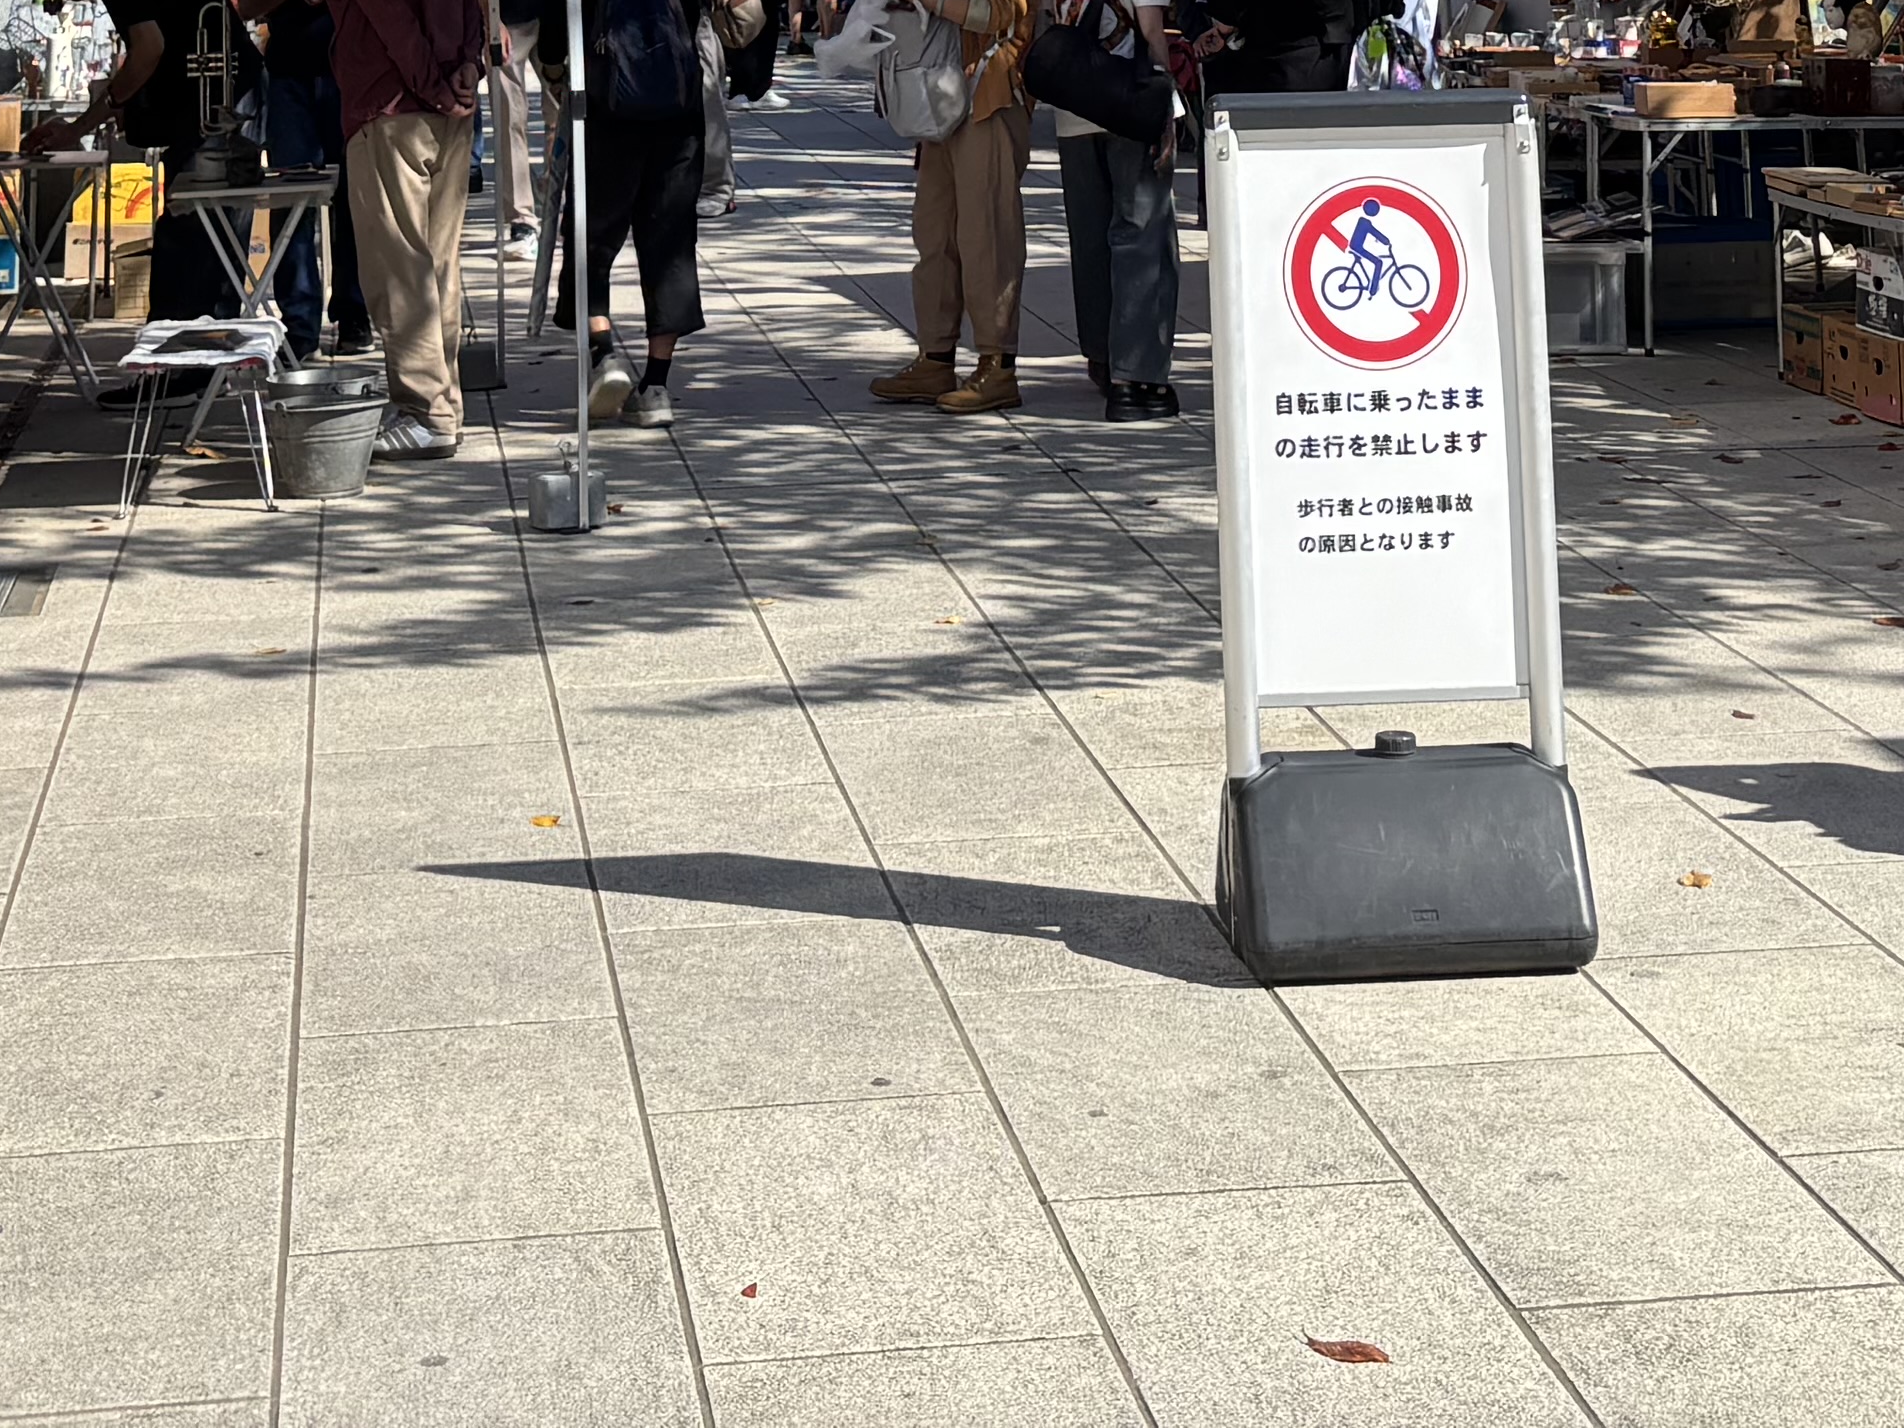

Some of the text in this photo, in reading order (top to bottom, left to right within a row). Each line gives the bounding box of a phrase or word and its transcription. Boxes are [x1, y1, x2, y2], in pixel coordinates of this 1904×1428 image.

[1276, 387, 1484, 415] 自転車に乗ったまま
[1275, 430, 1488, 458] の走行を禁止します
[1297, 493, 1473, 518] 歩行者との接触事故
[1298, 530, 1455, 553] の原因となります
